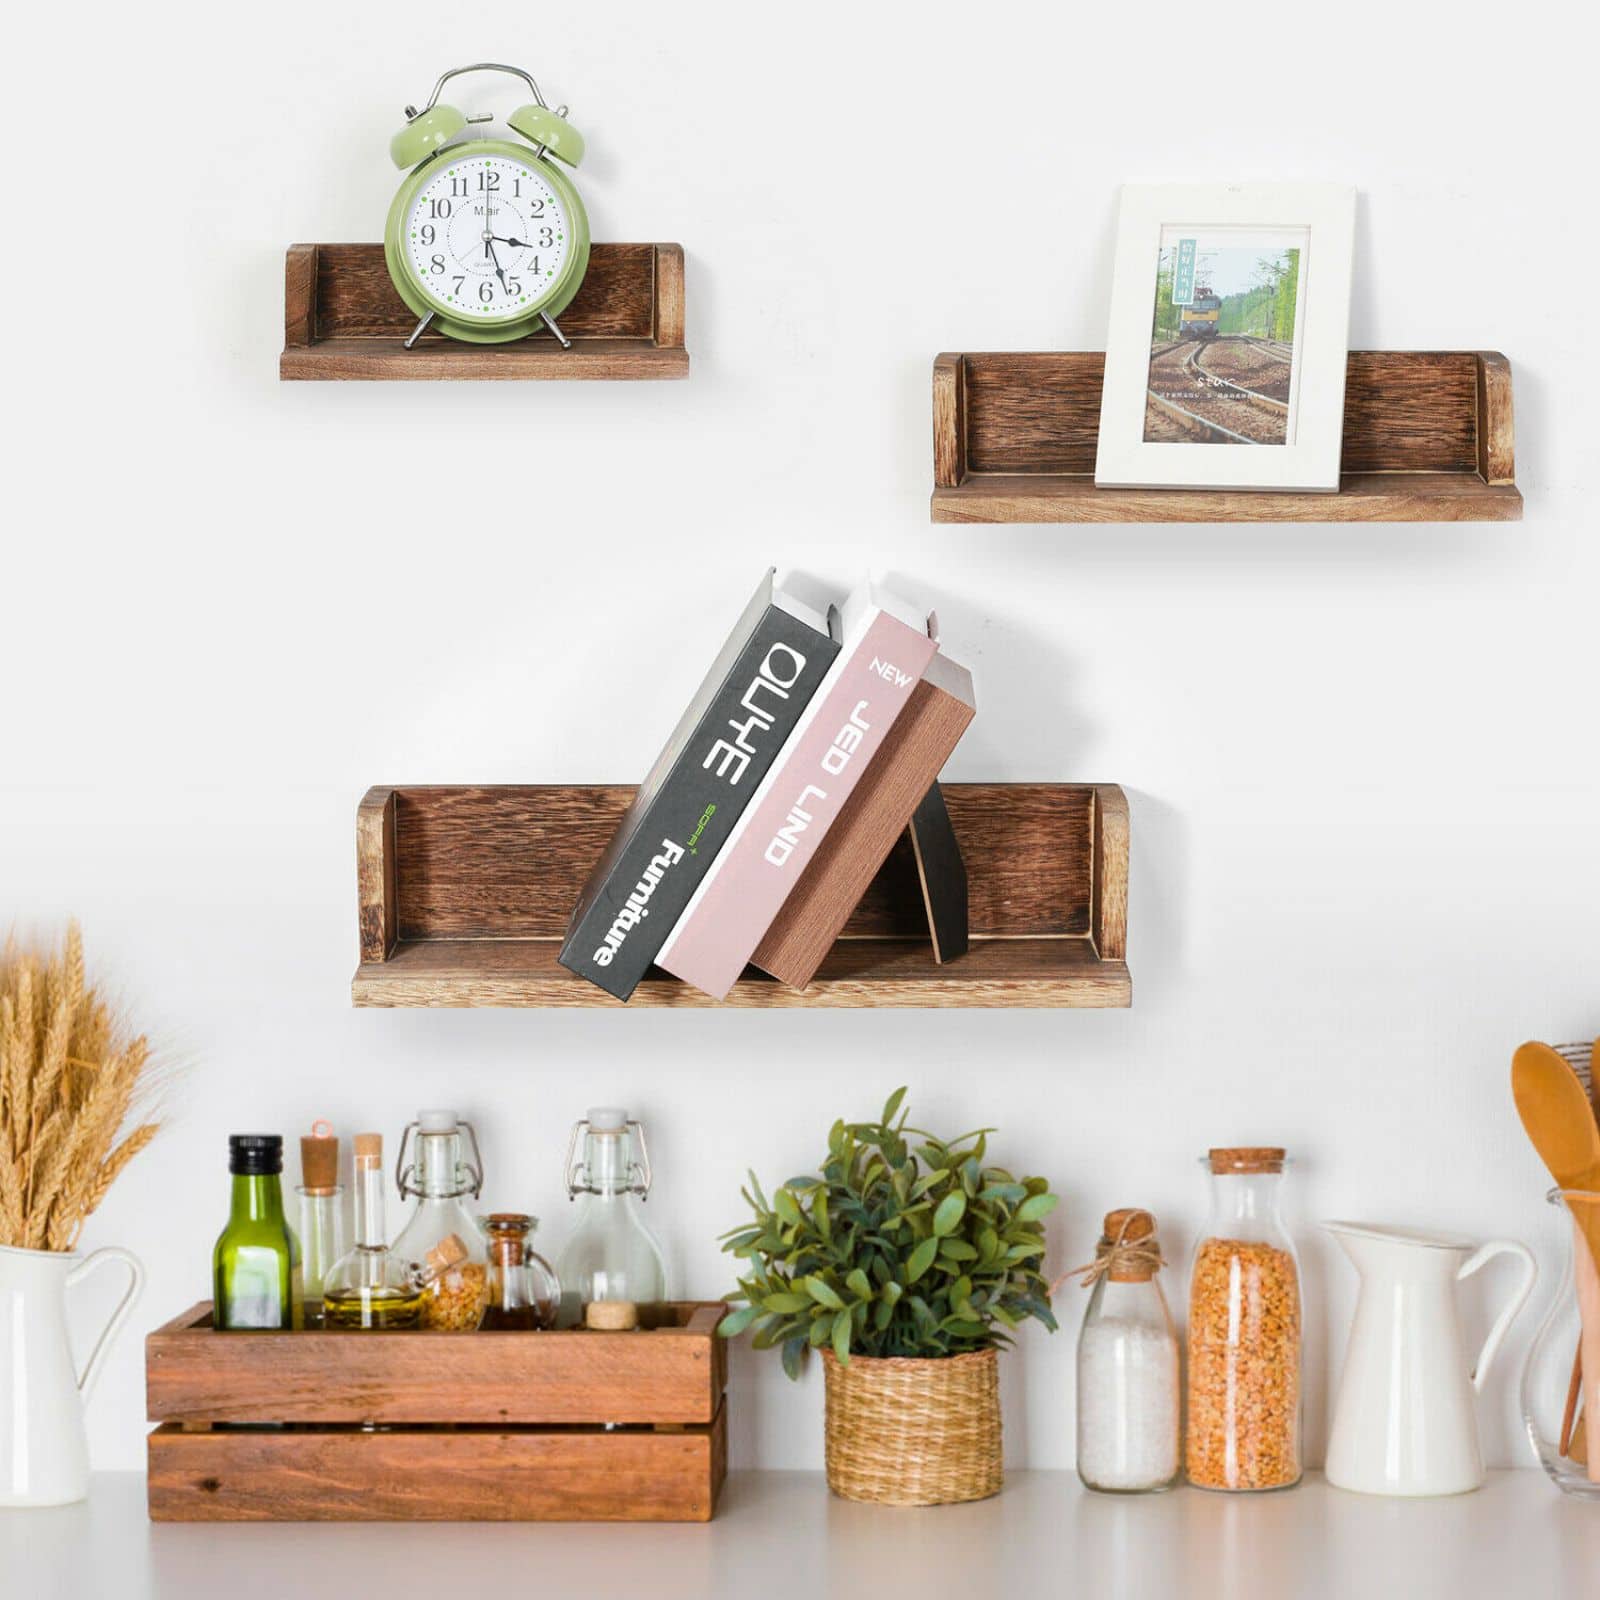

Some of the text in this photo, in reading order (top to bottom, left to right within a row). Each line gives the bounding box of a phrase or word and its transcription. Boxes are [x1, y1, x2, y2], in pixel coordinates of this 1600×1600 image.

[451, 178, 469, 197] 11
[477, 171, 500, 191] 12
[513, 178, 522, 198] 1
[429, 198, 452, 219] 10
[530, 199, 545, 219] 2
[420, 224, 436, 246] 9
[539, 227, 553, 248] 3
[430, 254, 446, 275] 8
[527, 255, 541, 275] 4
[452, 275, 465, 296] 7
[478, 281, 494, 303] 6
[508, 276, 522, 296] 5
[869, 656, 913, 688] NEW
[764, 700, 870, 867] JED LIND
[592, 838, 686, 967] Furniture
